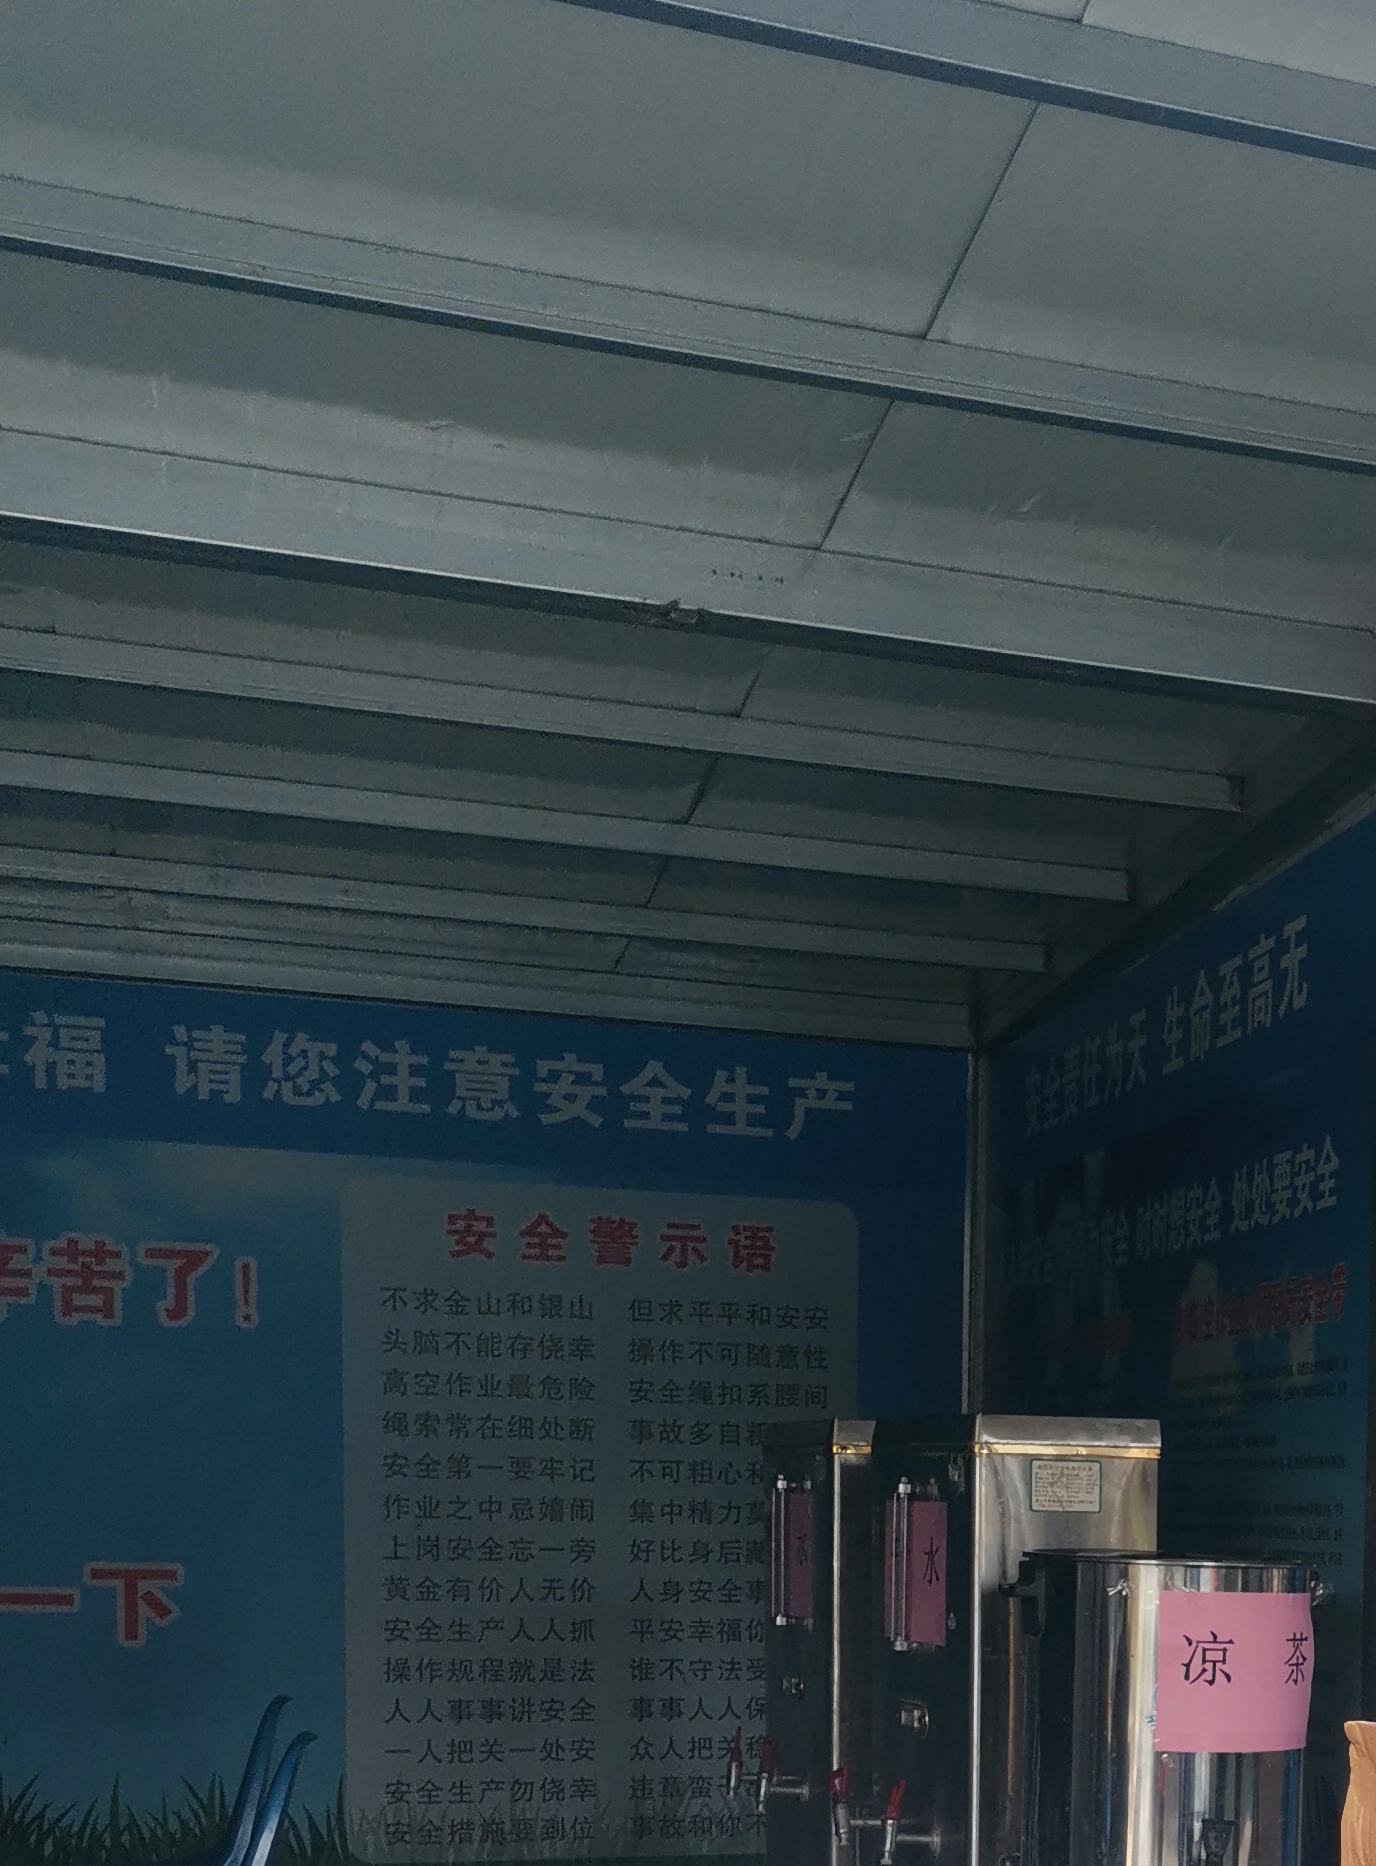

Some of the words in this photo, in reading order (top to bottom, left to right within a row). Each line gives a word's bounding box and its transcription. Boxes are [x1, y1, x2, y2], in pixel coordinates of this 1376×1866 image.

[1162, 914, 1308, 1075] 生命至高无
[0, 1012, 107, 1094] 福
[165, 1023, 855, 1140] 请您注意安全生产
[1230, 1134, 1339, 1235] 处处要安全
[445, 1208, 777, 1273] 安全警示语
[381, 1286, 594, 1322] 不求金山和银山
[628, 1298, 829, 1332] 但求平平和安安
[382, 1328, 596, 1362] 头脑不能存侥幸
[628, 1337, 829, 1371] 操作不可随意性
[382, 1369, 596, 1403] 高空作业最危险
[628, 1379, 828, 1409] 安全绳扣系腰间
[382, 1411, 595, 1442] 绳索常在细处断
[382, 1451, 596, 1484] 安全第一要牢记
[382, 1494, 595, 1525] 作业之中忌嬉闹
[382, 1534, 596, 1564] 上岗安全忘一旁
[382, 1575, 596, 1604] 黄金有价人无价
[382, 1615, 596, 1644] 安全生产人人抓
[383, 1656, 596, 1685] 操作规程就是法
[1180, 1630, 1309, 1687] 凉茶
[384, 1696, 596, 1725] 人人事事讲安全
[384, 1736, 596, 1765] 一人把关一处安
[384, 1777, 596, 1807] 安全生产勿侥幸
[384, 1816, 596, 1847] 安全措施要到位
